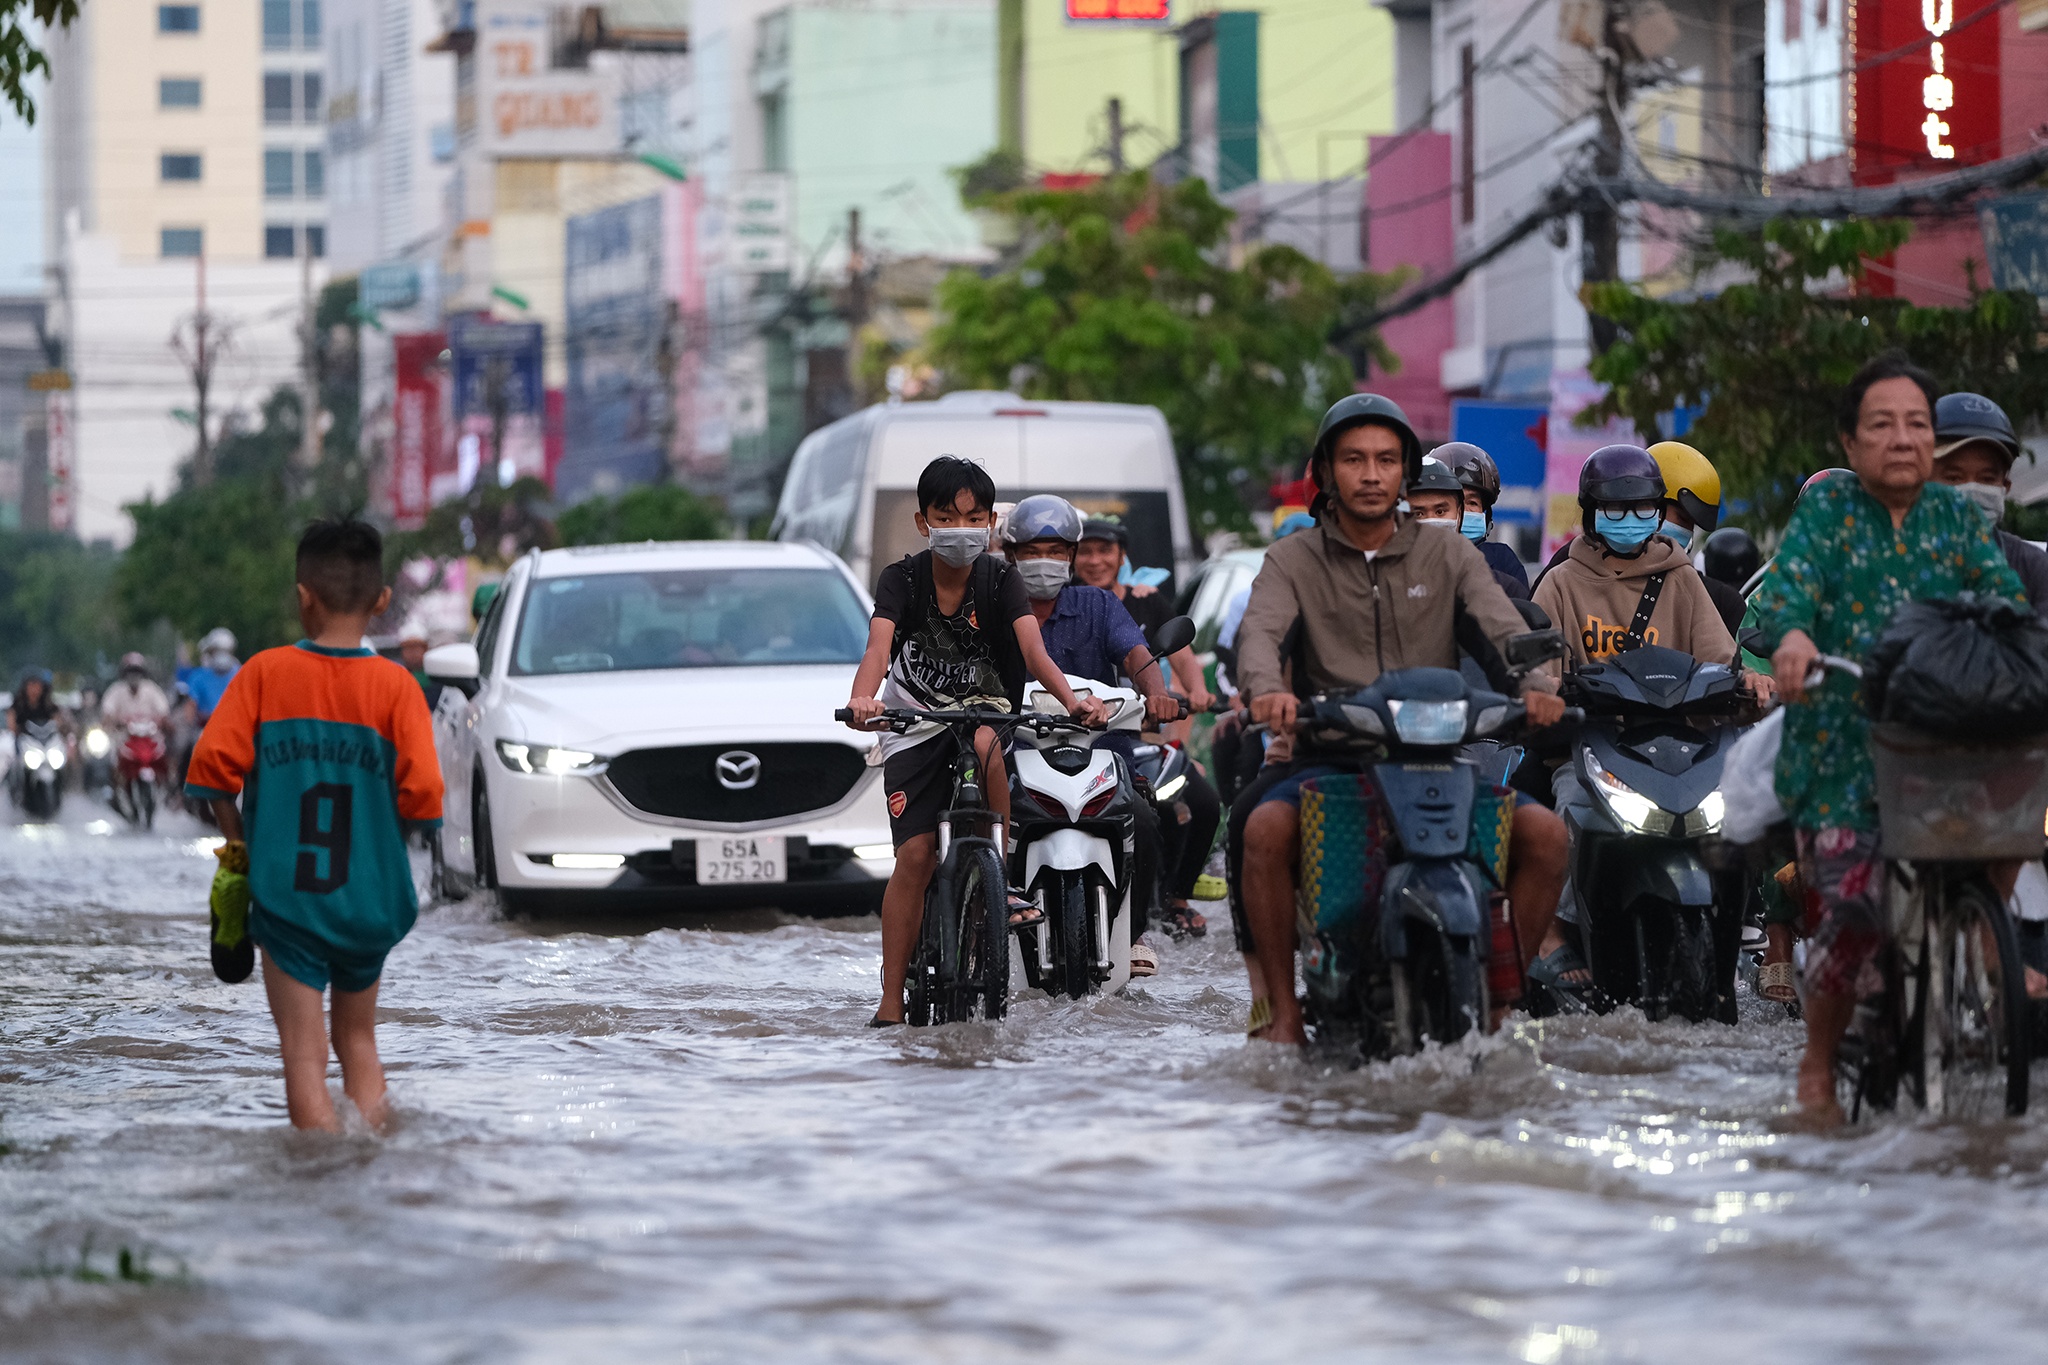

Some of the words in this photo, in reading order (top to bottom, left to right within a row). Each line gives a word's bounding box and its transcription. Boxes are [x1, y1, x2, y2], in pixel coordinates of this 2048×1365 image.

[294, 782, 353, 894] 9
[722, 840, 759, 859] 65A
[708, 860, 775, 882] 275.20
